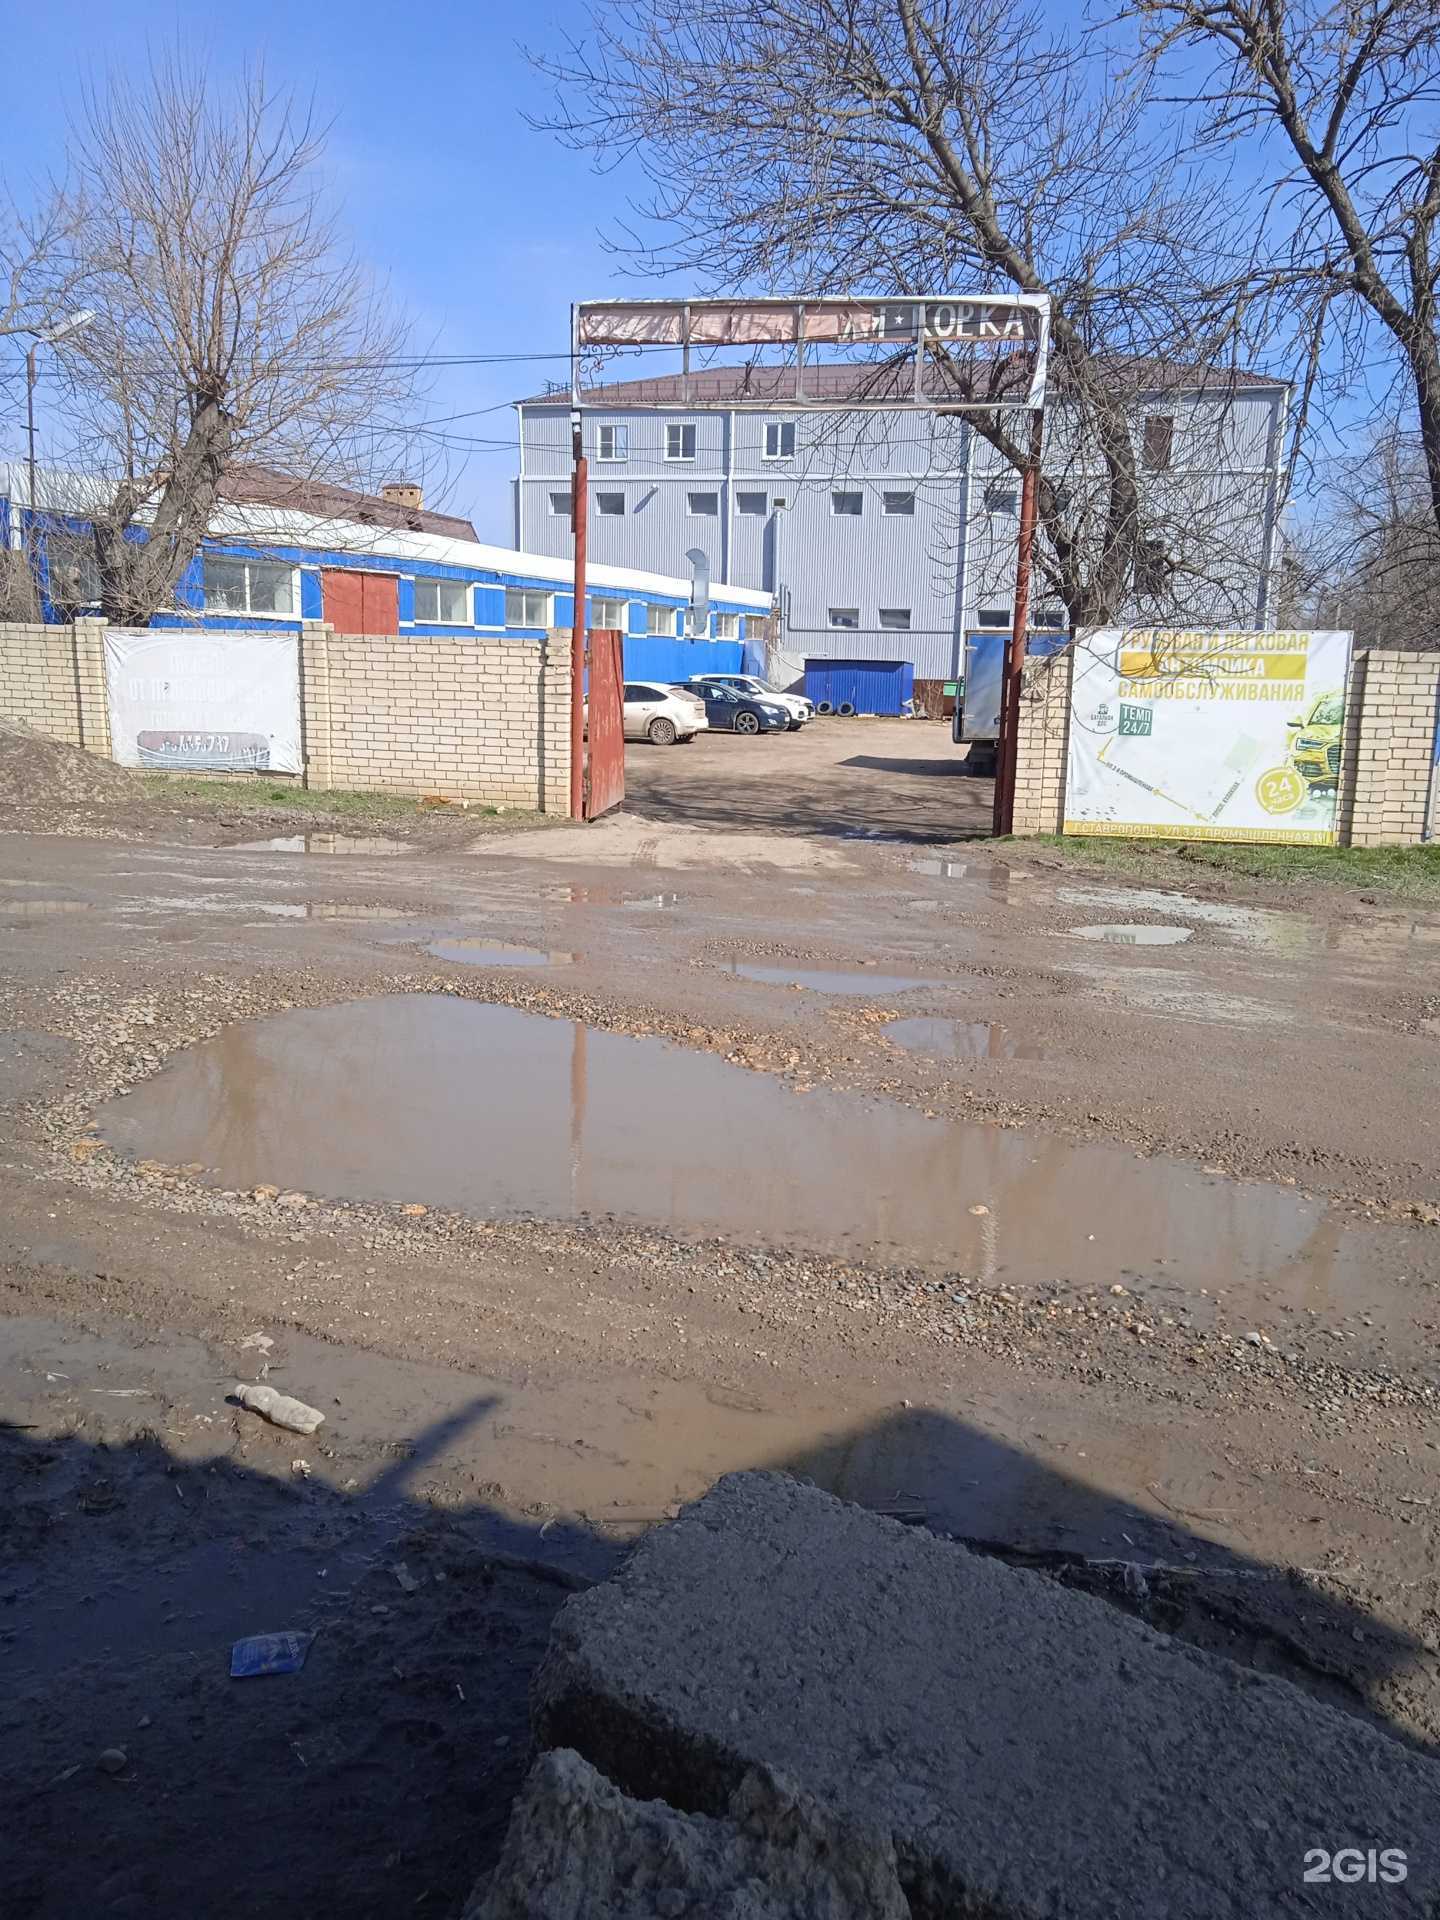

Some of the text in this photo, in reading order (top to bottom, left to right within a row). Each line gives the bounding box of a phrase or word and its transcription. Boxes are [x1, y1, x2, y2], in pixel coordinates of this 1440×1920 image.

[1118, 681, 1305, 701] САМООБСЛУЖИВАНИЯ
[1122, 705, 1151, 722] ТЕМП
[1123, 720, 1150, 734] 24/7
[1265, 776, 1292, 798] 24
